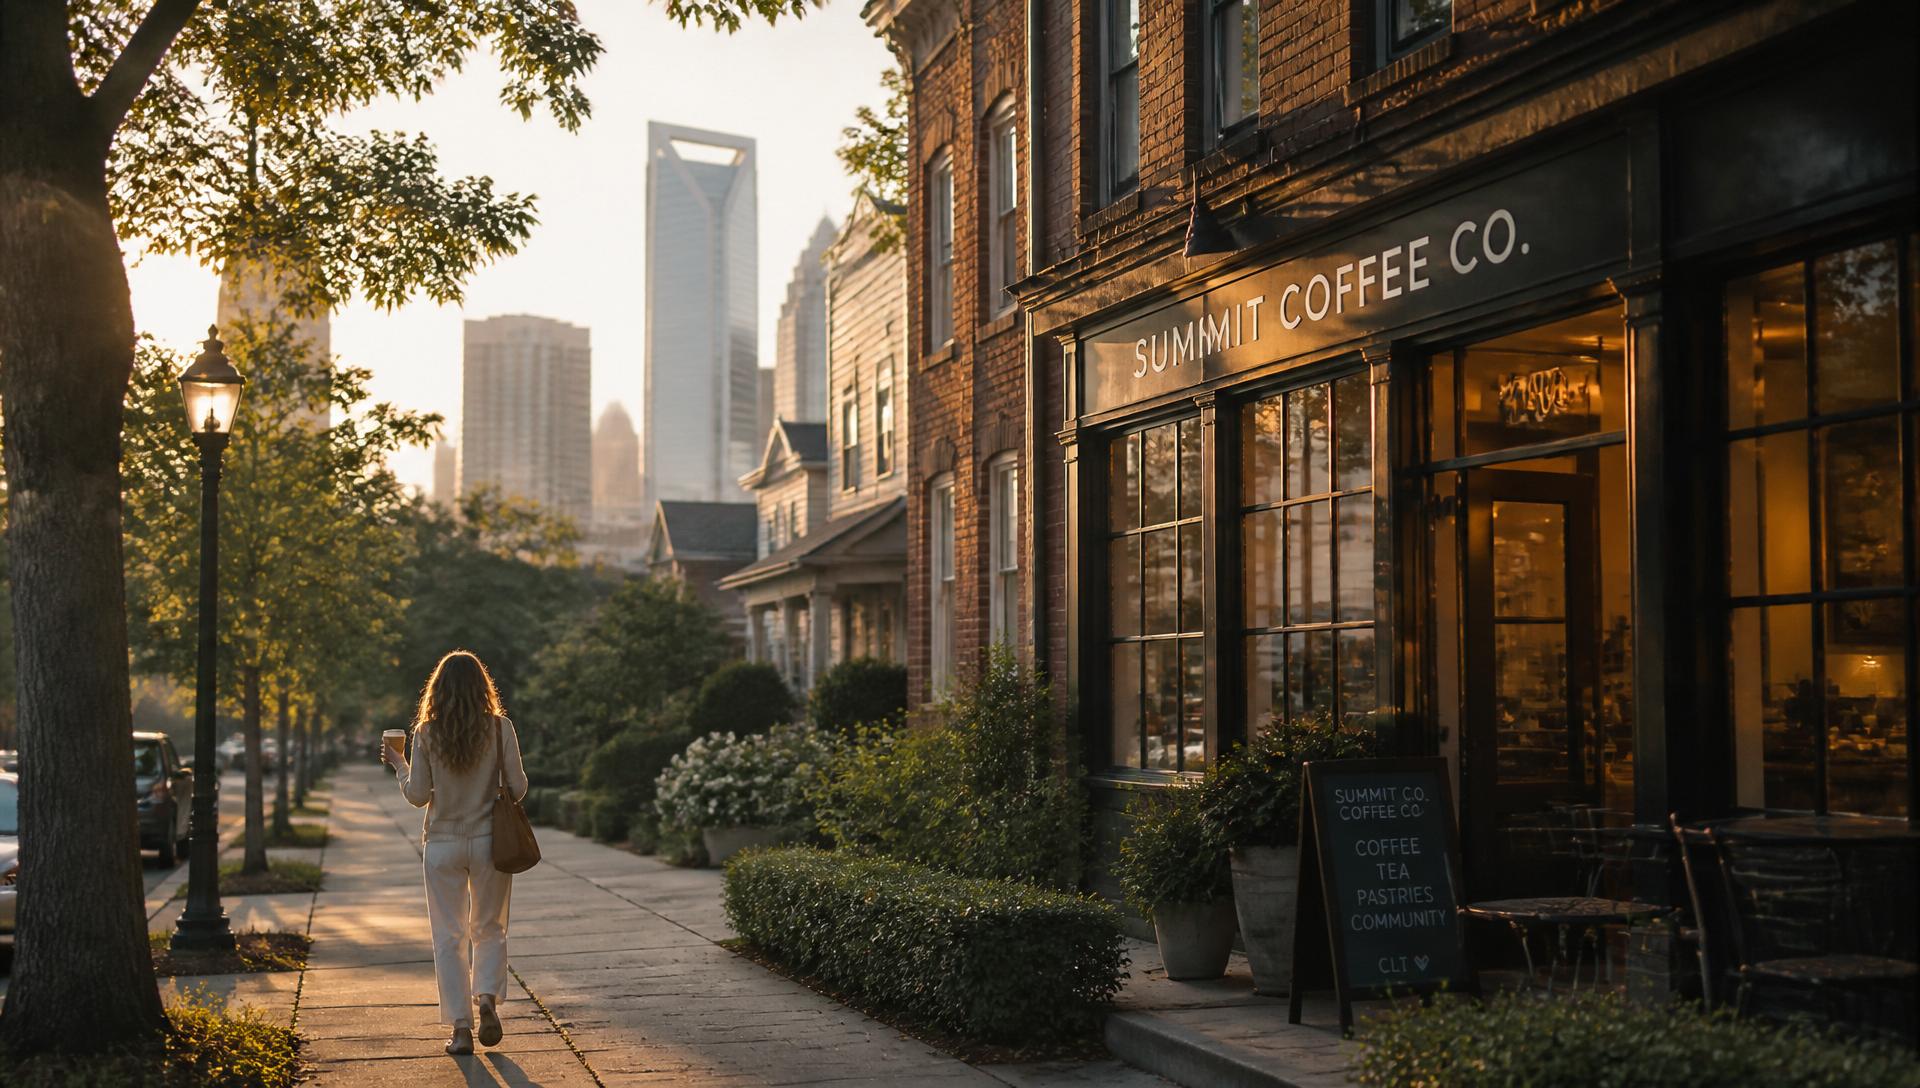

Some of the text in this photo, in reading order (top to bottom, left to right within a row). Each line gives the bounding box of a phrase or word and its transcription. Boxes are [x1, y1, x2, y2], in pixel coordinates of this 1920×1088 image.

[1280, 236, 1430, 330] COFFEE
[1450, 208, 1530, 275] CO.
[1335, 787, 1398, 804] SUMMIT
[1339, 804, 1397, 821] COFFEE
[1355, 837, 1421, 856] COFFEE
[1376, 862, 1410, 881] TEA
[1357, 886, 1434, 906] PASTRIES
[1351, 909, 1447, 931] COMMUNITY
[1378, 956, 1408, 974] CLT
